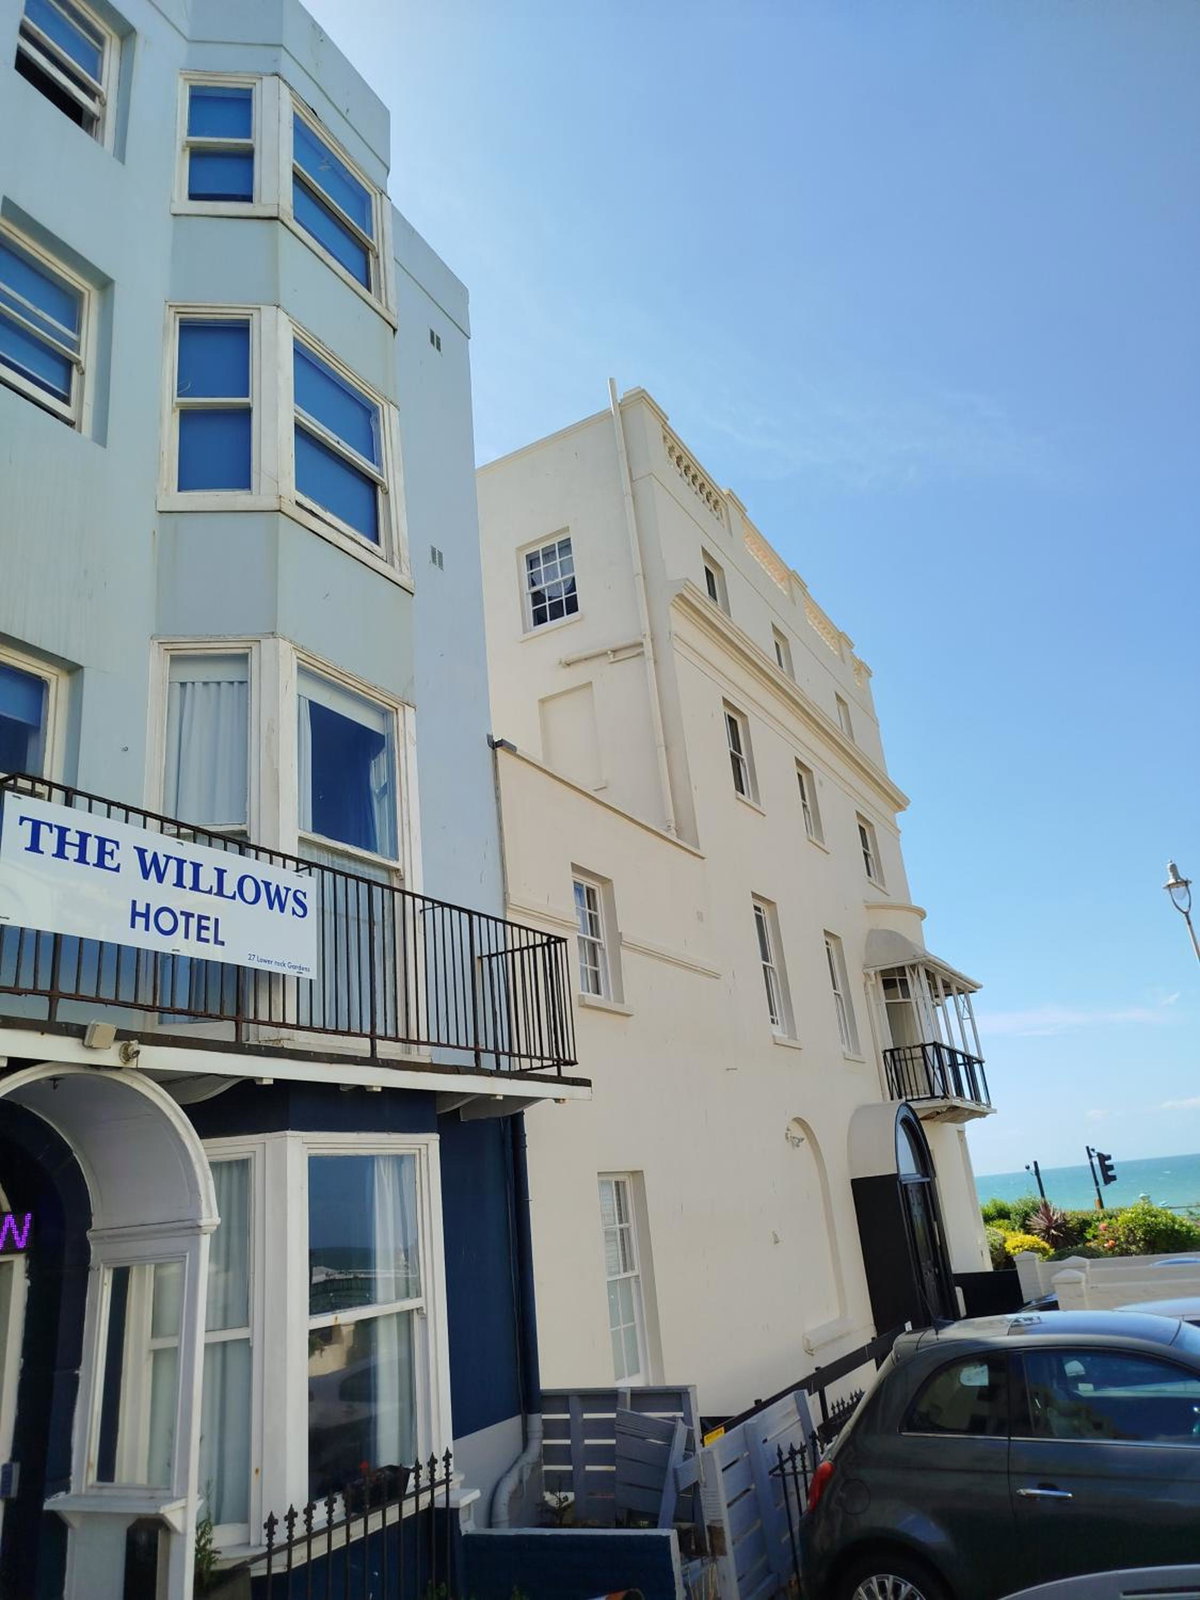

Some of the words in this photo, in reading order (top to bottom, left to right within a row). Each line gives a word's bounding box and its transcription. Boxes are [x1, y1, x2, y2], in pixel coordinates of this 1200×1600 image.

[19, 815, 121, 873] THE
[133, 845, 308, 918] WILLOWS
[129, 899, 225, 946] HOTEL
[247, 953, 256, 961] 27
[257, 955, 273, 965] Lower
[287, 961, 311, 972] Gardens
